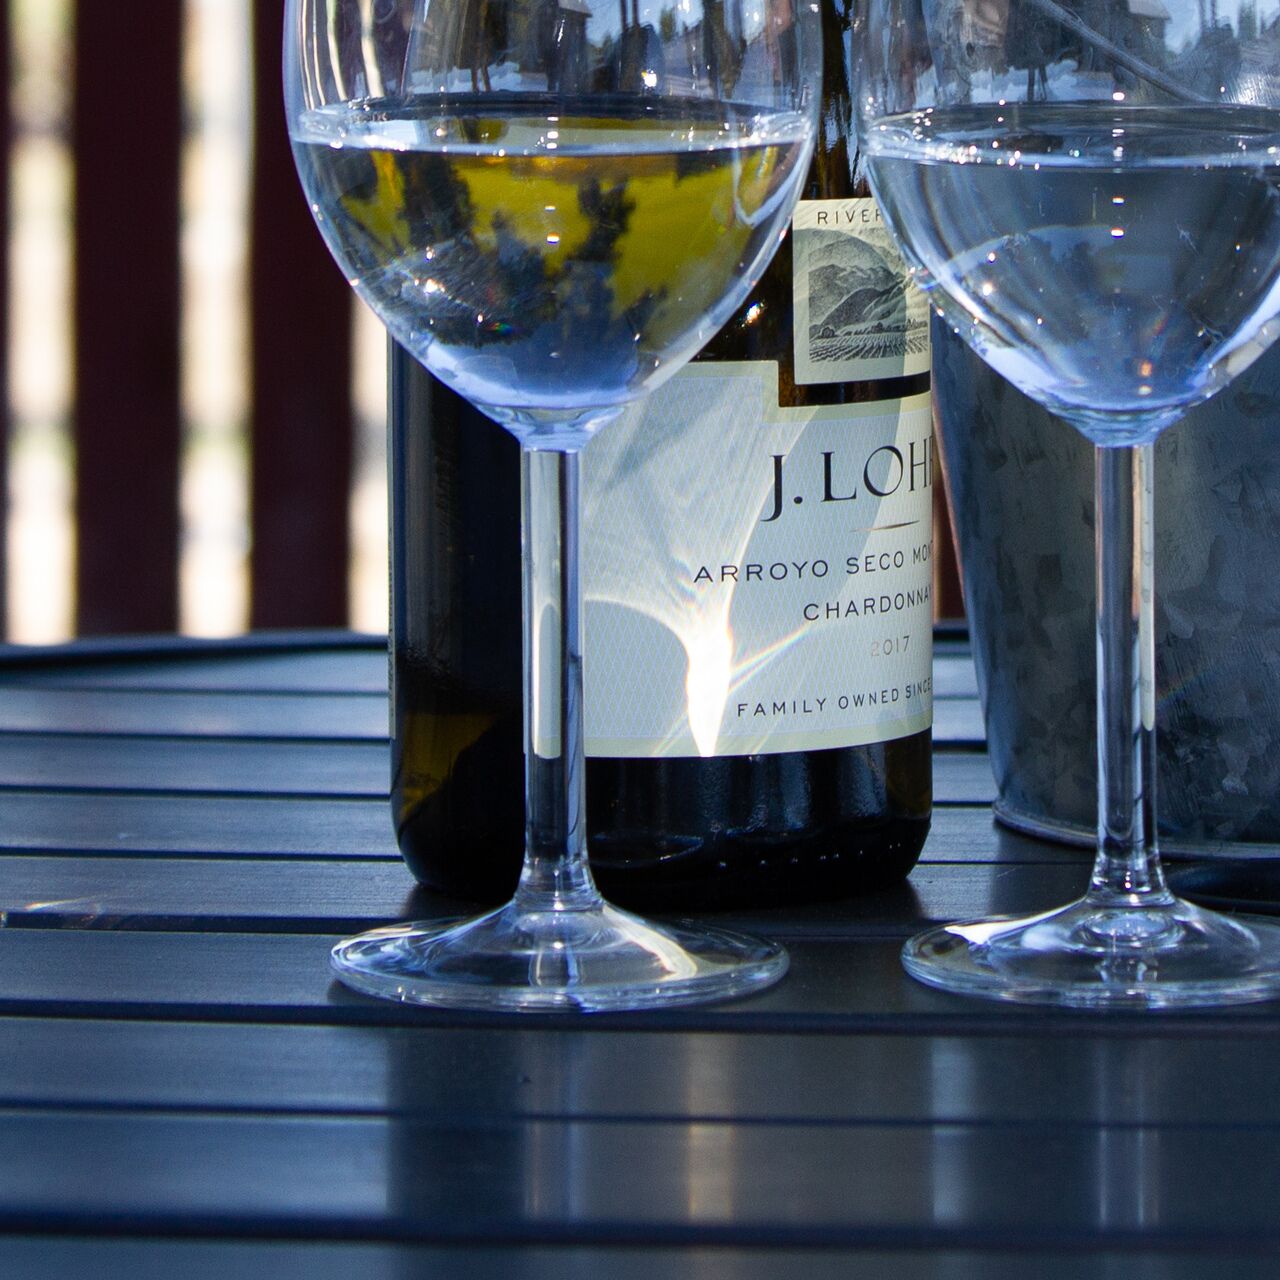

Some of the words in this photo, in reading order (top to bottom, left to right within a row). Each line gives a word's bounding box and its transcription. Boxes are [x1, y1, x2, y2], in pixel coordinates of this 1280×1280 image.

[760, 454, 803, 522] J.
[693, 559, 828, 583] ARROYO
[846, 550, 904, 575] SECO
[871, 635, 910, 656] 2017
[737, 698, 826, 718] FAMILY
[838, 688, 899, 710] OWNED
[905, 677, 932, 699] SINCE
